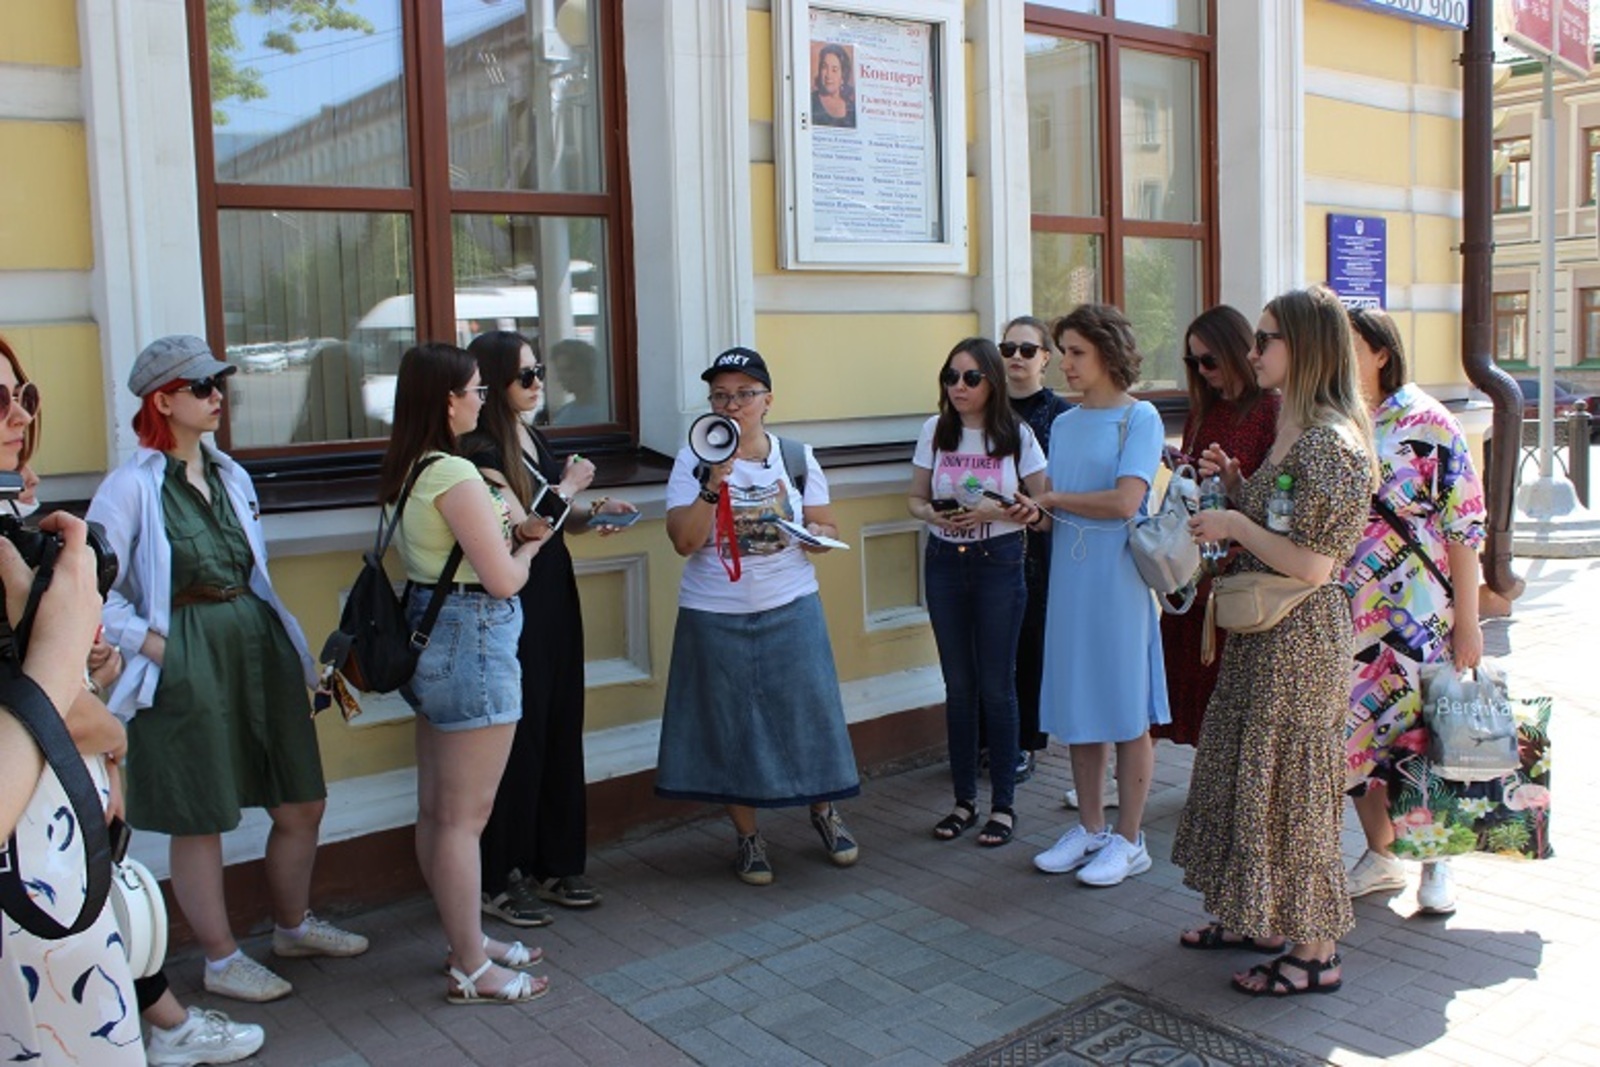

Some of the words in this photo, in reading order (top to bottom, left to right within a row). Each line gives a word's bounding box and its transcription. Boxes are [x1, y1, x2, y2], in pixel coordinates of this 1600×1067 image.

[1429, 0, 1465, 24] 900
[860, 64, 924, 87] Концерт
[719, 354, 750, 366] OBEY
[972, 457, 993, 469] LIKE
[993, 458, 1001, 469] IT
[980, 521, 992, 539] IT
